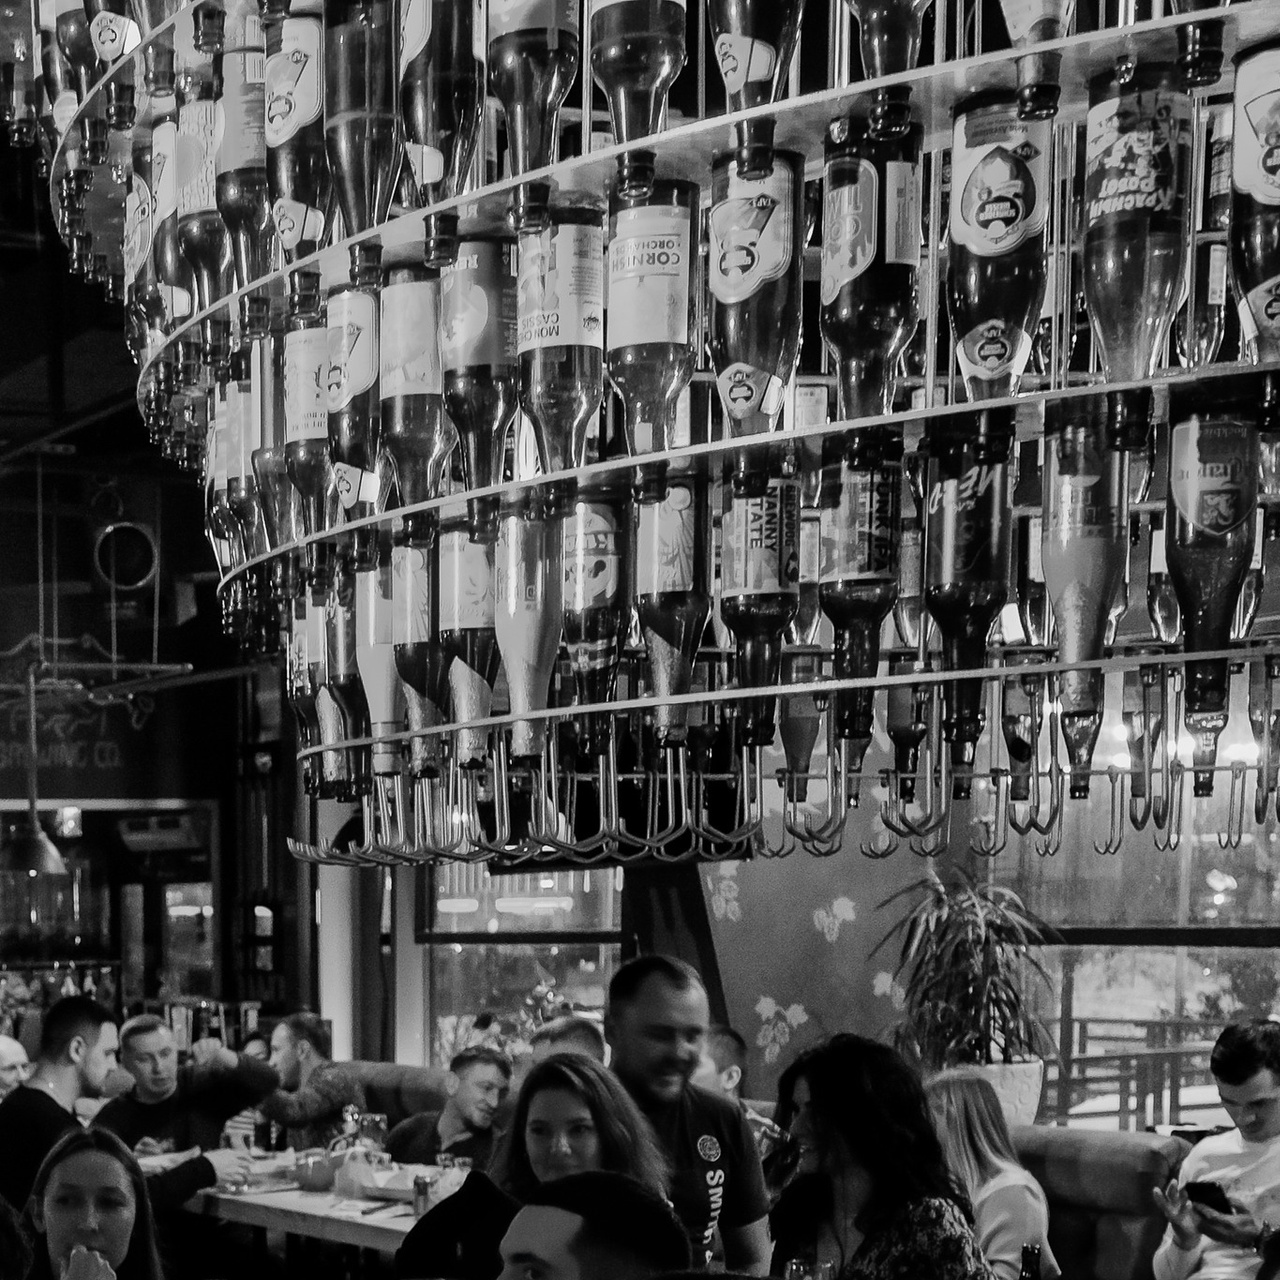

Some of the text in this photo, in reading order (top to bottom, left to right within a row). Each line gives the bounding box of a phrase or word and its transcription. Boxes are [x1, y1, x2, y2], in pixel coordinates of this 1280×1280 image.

[612, 252, 681, 273] CORNISH
[522, 312, 560, 331] CASSIS
[534, 324, 561, 339] MON
[750, 498, 764, 549] TATE
[764, 486, 778, 552] NANNY
[873, 468, 890, 574] PUNK IPA
